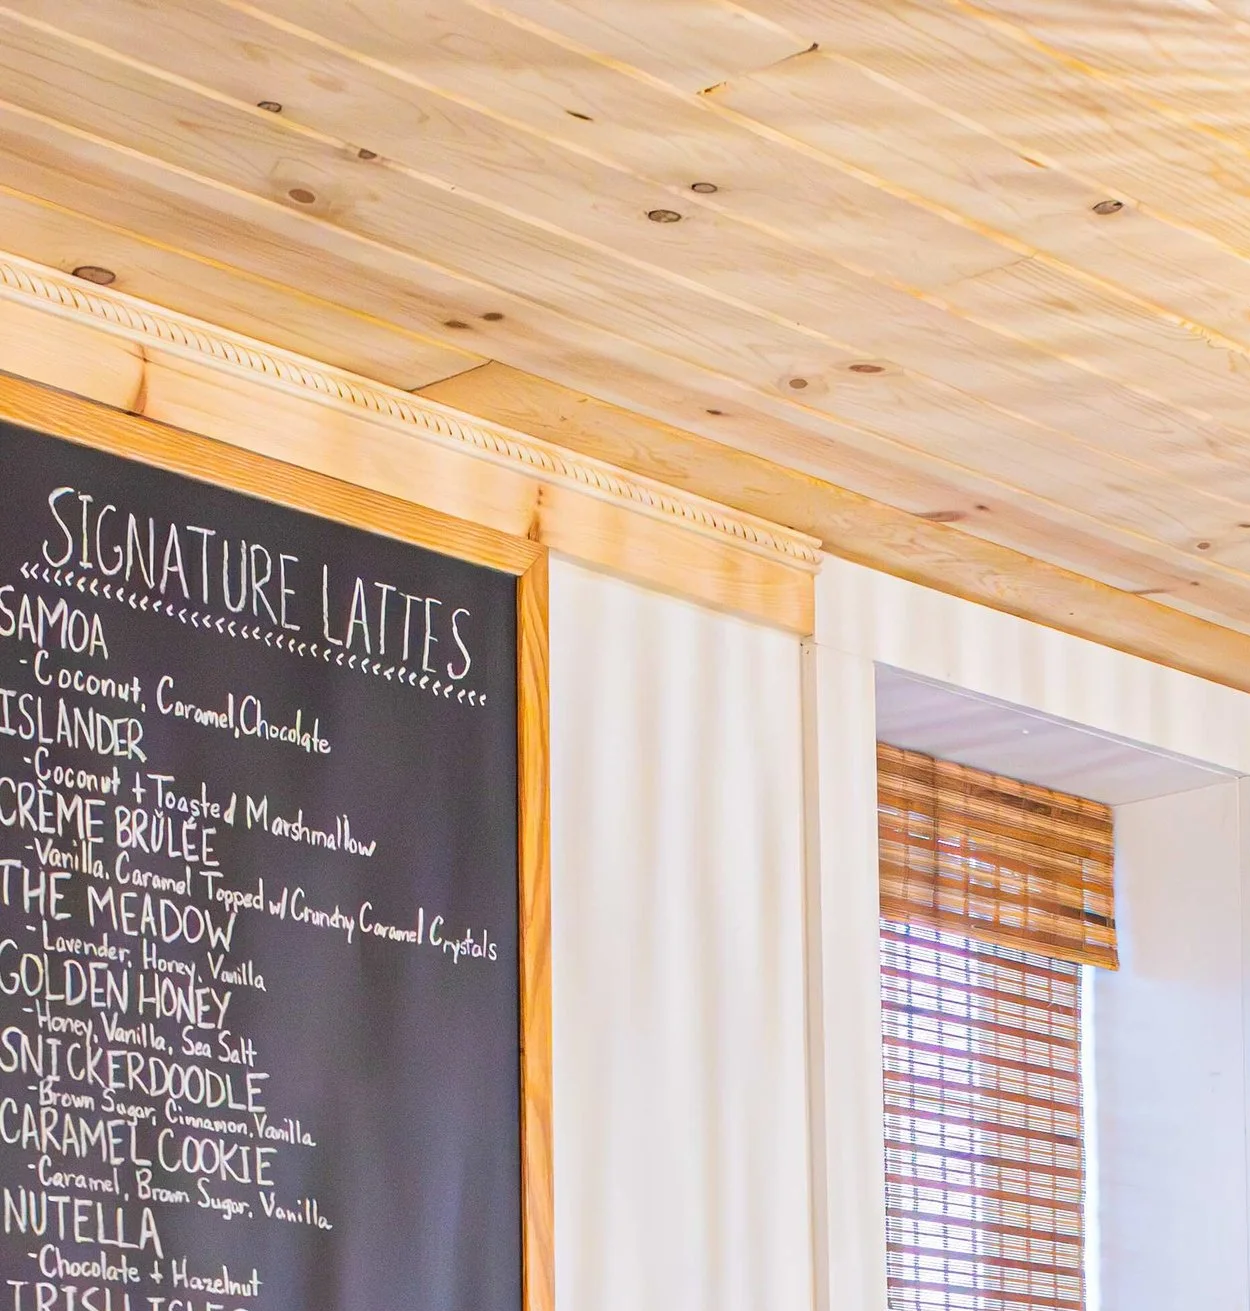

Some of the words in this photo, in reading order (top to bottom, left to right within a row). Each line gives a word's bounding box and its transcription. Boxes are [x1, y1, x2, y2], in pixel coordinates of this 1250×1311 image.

[42, 486, 301, 631] SIGNATURE
[321, 564, 471, 680] LATTES
[0, 584, 109, 660] SAMOA
[0, 689, 147, 763] ISLANDER
[147, 774, 237, 827] Toasted
[246, 794, 377, 857] Marshmallow
[0, 858, 72, 921] THE
[87, 885, 237, 953] MEADOW
[115, 850, 192, 897] Caramel
[200, 870, 264, 912] Topped
[359, 901, 424, 944] Caramel
[429, 914, 498, 964] Crystals
[0, 938, 129, 1015] GOLDEN
[138, 971, 232, 1030] HONEY
[207, 951, 267, 993] Vanilla
[0, 1026, 270, 1112] SNICKERDOODLE
[181, 1025, 213, 1059] Sea
[217, 1030, 257, 1068] Salt
[0, 1098, 152, 1169] CARAMEL
[158, 1127, 278, 1187] COOKIE
[253, 1112, 317, 1148] Vanilla
[3, 1186, 164, 1260] NUTELLA
[259, 1190, 334, 1231] Vanilla
[172, 1256, 264, 1298] Hazelnut
